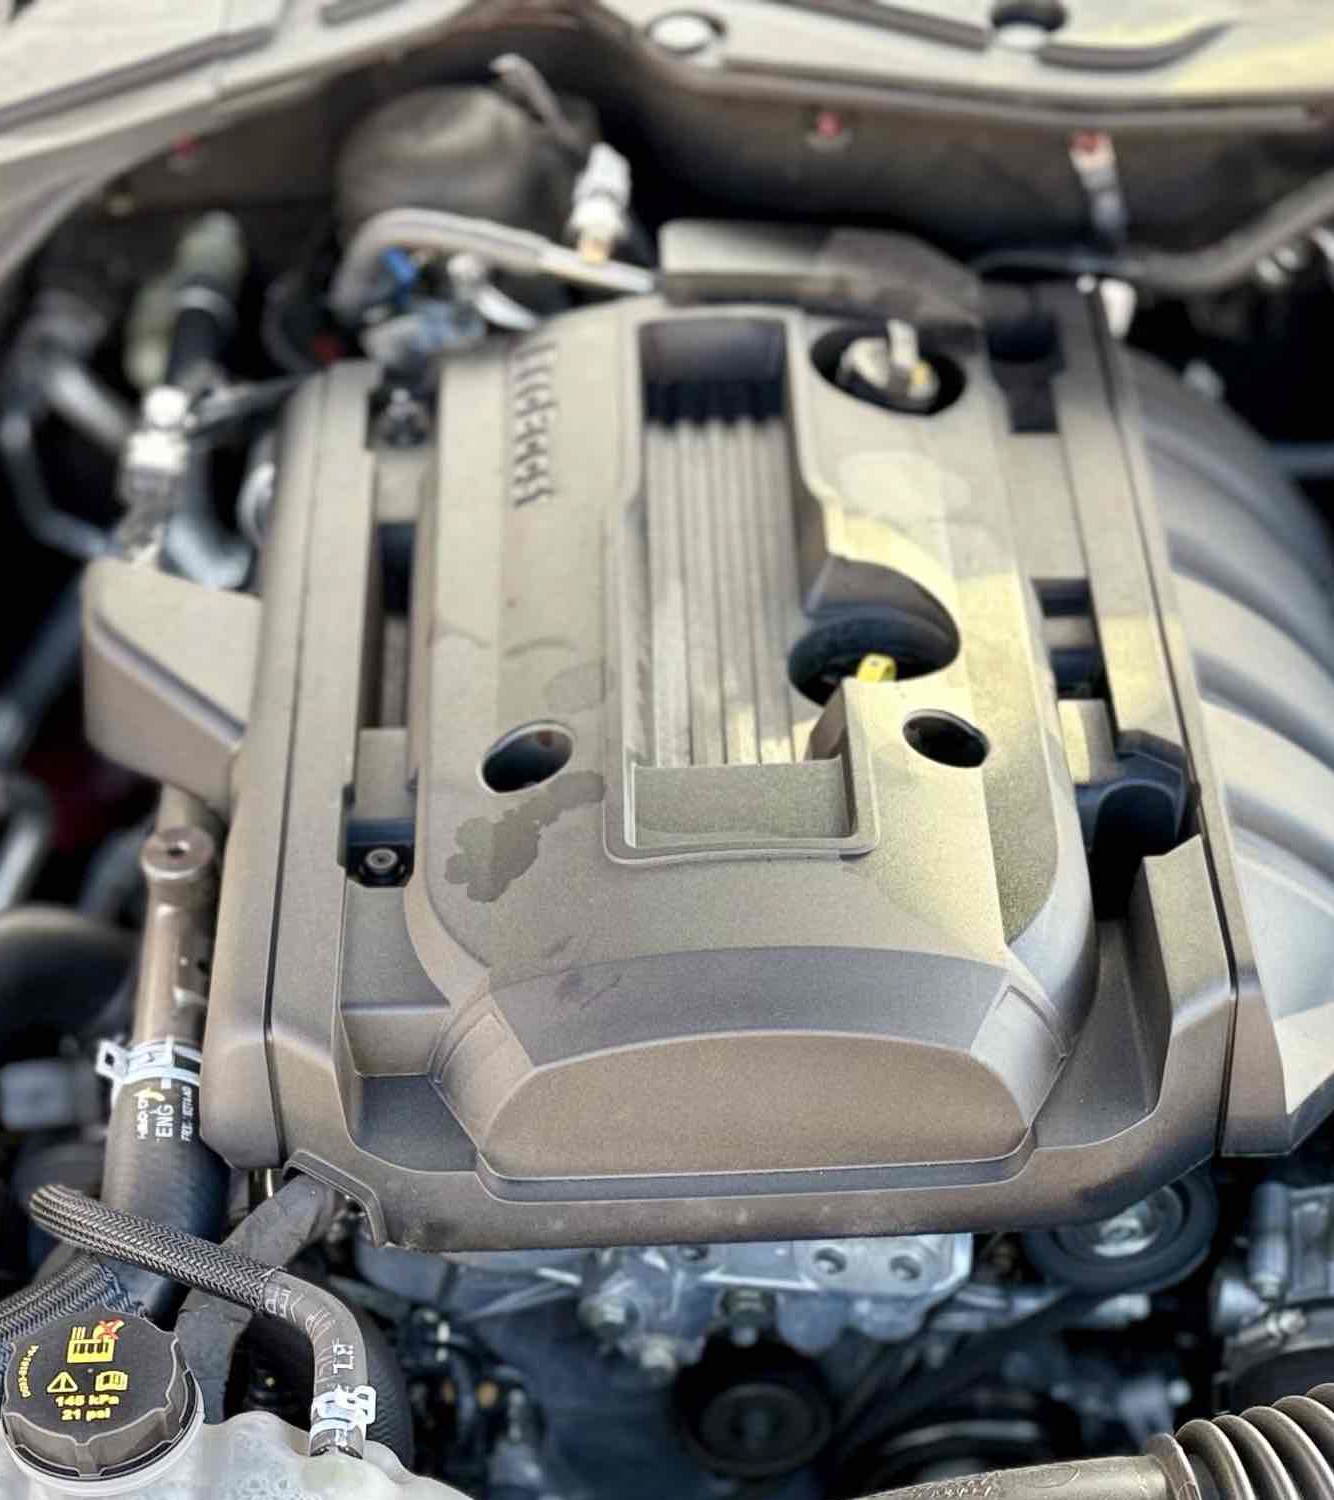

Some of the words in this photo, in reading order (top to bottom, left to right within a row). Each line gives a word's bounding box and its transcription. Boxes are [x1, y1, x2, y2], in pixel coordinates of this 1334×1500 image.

[155, 1103, 174, 1138] ENG
[55, 1395, 84, 1407] 145
[88, 1394, 120, 1406] kPa
[61, 1409, 81, 1421] 21
[85, 1408, 111, 1422] psi
